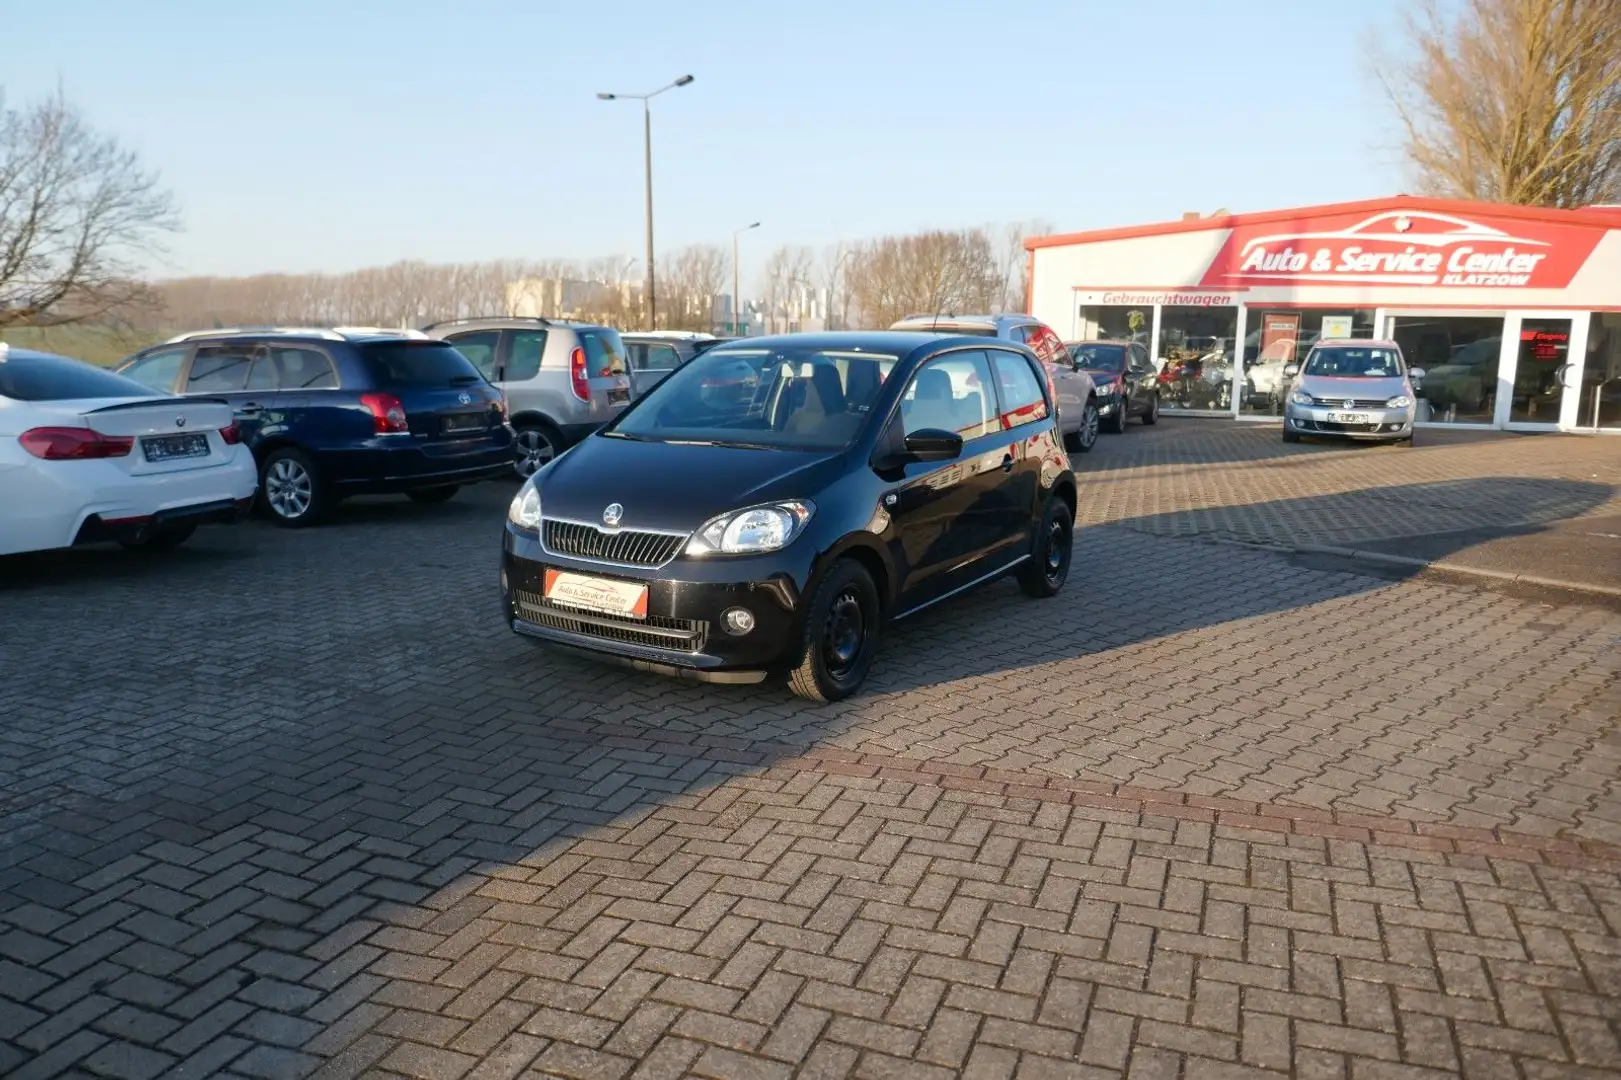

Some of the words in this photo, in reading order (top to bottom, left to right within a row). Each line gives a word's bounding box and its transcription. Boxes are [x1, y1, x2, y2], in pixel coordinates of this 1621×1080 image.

[1241, 247, 1308, 271] Auto
[1310, 248, 1332, 271] &
[1335, 246, 1442, 272] Service
[1447, 246, 1546, 273] Center
[1441, 274, 1531, 286] KLATZOW
[1102, 291, 1231, 307] Gebrauchtwagen
[558, 585, 573, 595] Auto
[580, 589, 605, 600] Service
[606, 593, 627, 605] Center
